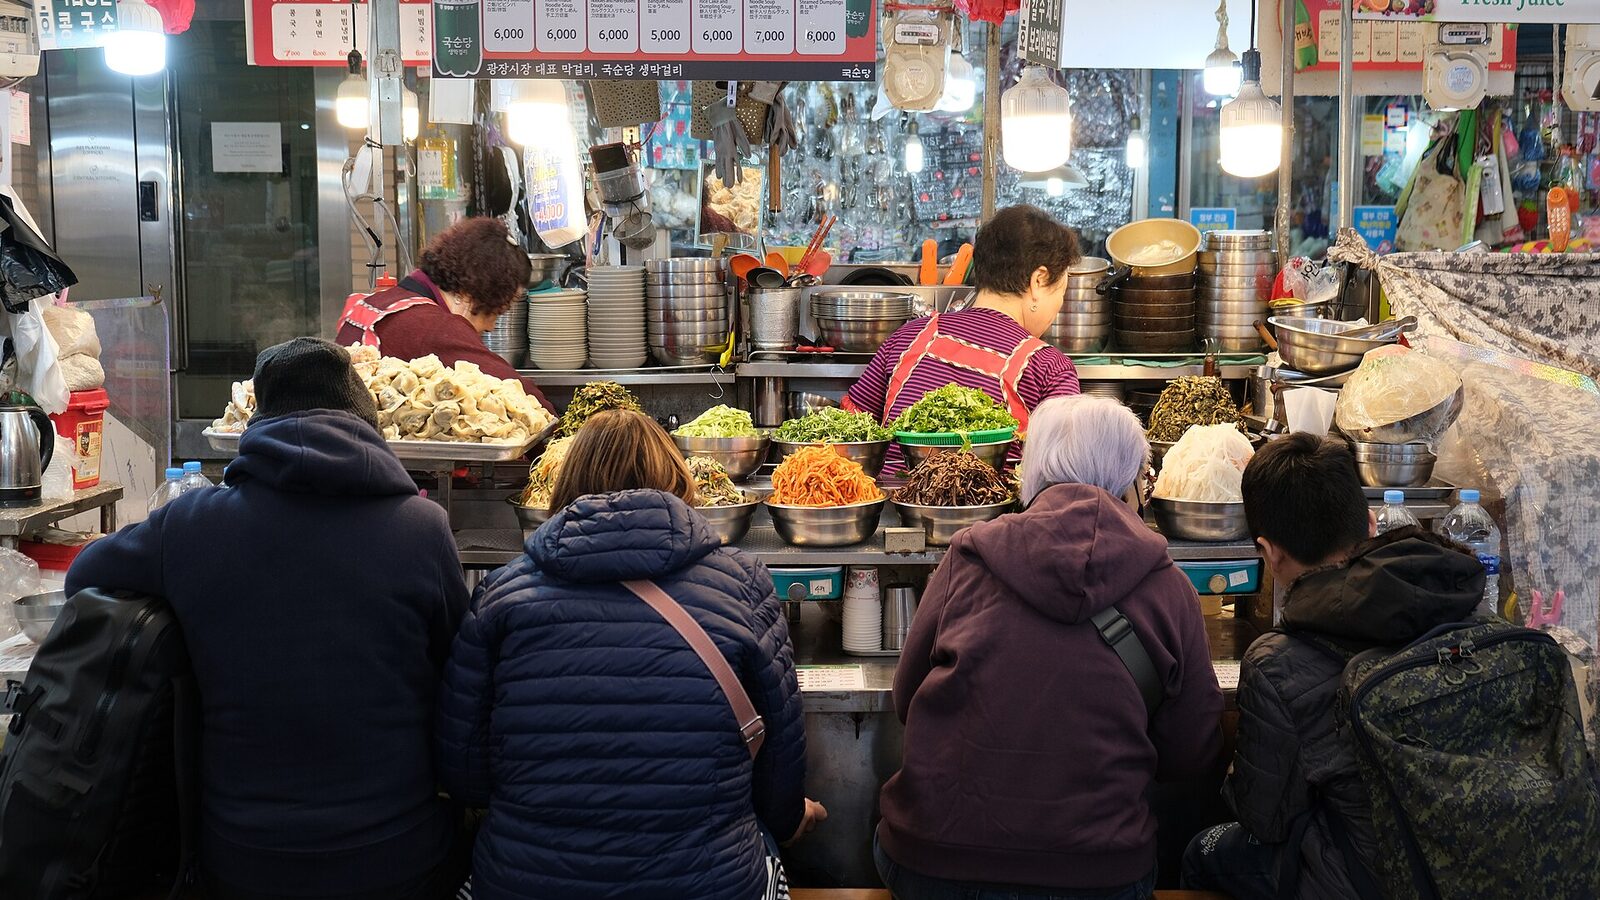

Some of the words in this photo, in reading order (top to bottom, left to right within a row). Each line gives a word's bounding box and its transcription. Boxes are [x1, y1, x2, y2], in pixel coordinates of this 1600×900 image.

[289, 8, 297, 39] 콩국수
[315, 8, 323, 39] 물냉면
[340, 8, 349, 44] 비빔냉면
[417, 8, 426, 44] 비빔국수
[493, 28, 524, 41] 6,000
[546, 29, 577, 42] 6,000
[598, 29, 629, 42] 6,000
[650, 29, 681, 42] 5,000
[702, 30, 733, 43] 6,000
[755, 30, 785, 44] 7,000
[806, 31, 836, 44] 6,000
[441, 36, 473, 49] 국순당
[1028, 26, 1059, 62] 보리비빔밥
[486, 63, 532, 76] 광장시장
[535, 63, 558, 76] 대표
[561, 63, 598, 77] 막걸리,
[601, 63, 635, 76] 국순당
[638, 64, 683, 76] 생막걸리
[841, 65, 872, 79] 국순당
